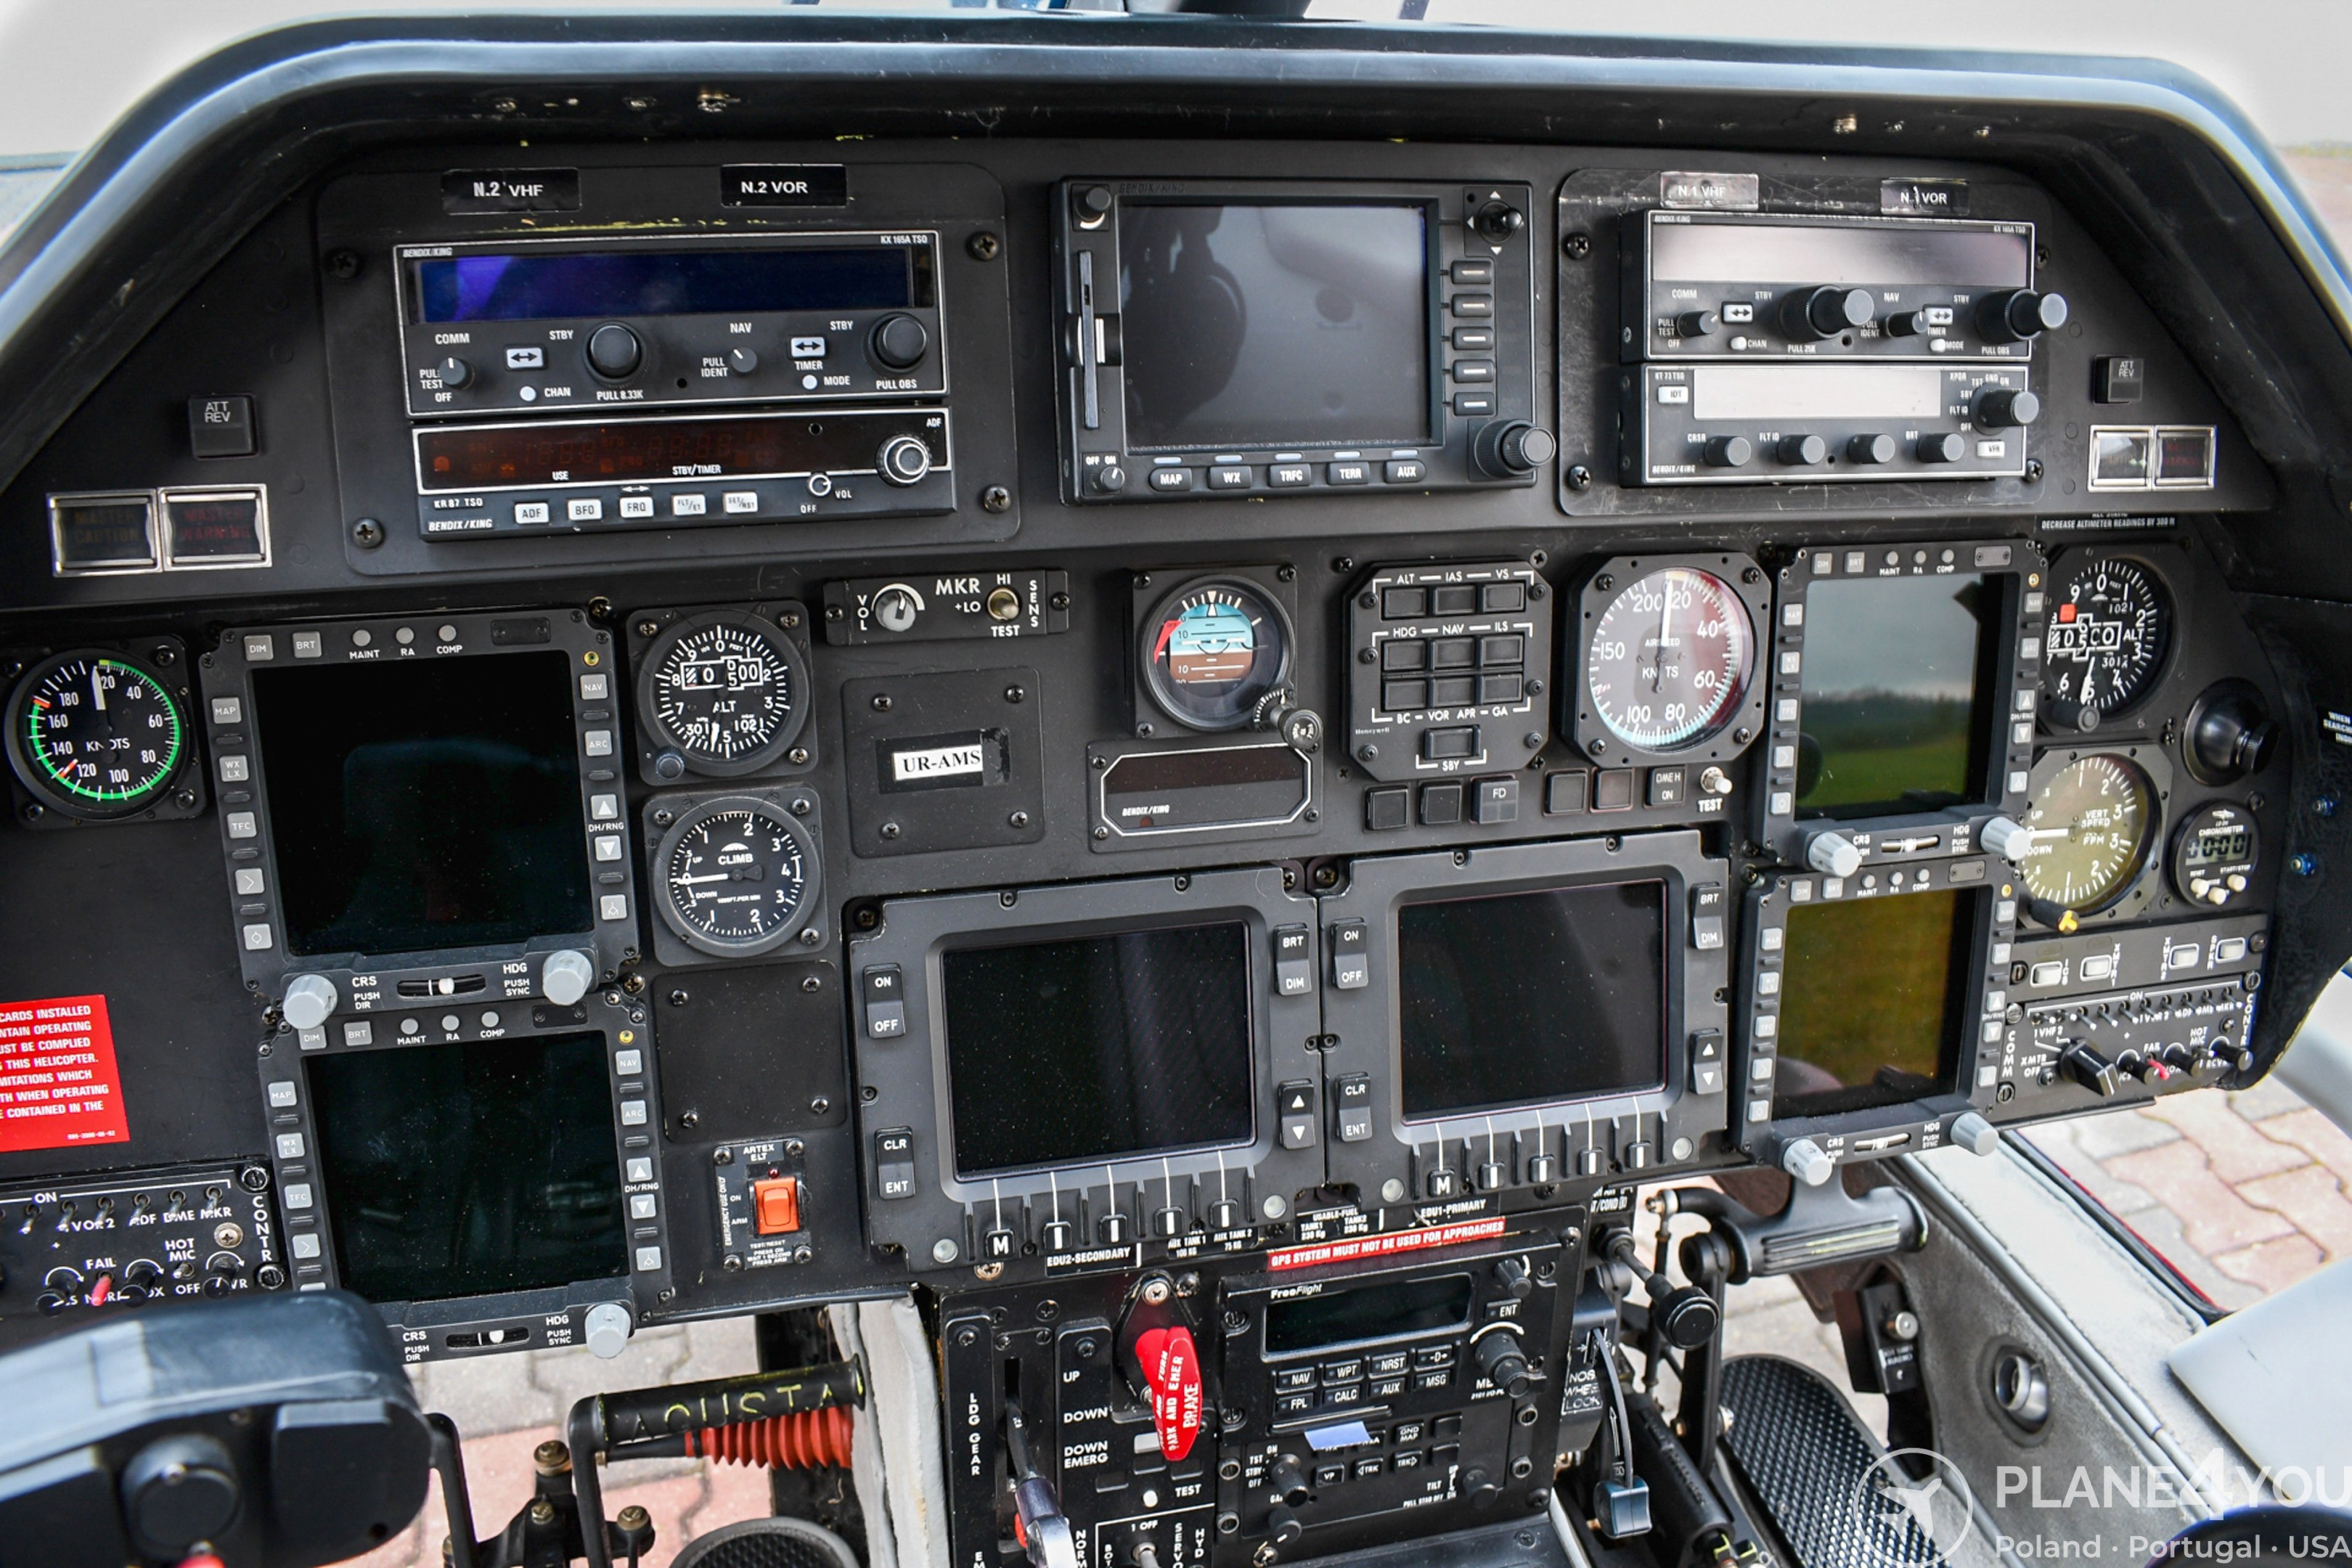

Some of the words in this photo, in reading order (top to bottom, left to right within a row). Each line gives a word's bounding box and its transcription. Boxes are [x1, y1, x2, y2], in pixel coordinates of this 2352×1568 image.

[473, 181, 501, 197] N.2
[508, 184, 544, 197] VHF
[740, 181, 767, 194] N.2
[771, 181, 808, 194] VOR
[1678, 185, 1697, 196] N.1
[1701, 185, 1726, 197] VHF
[1671, 289, 1697, 299] COMM
[1755, 291, 1772, 301] STBY
[1883, 292, 1900, 303] NAV
[729, 322, 753, 335] NAV
[829, 320, 854, 331] STBY
[435, 332, 470, 346] COMM
[549, 330, 574, 341] STBY
[1747, 339, 1767, 348] CHAN
[794, 360, 823, 371] TIMER
[701, 367, 729, 378] IDENT
[823, 375, 851, 387] MODE
[435, 392, 453, 403] OFF
[544, 386, 571, 398] CHAN
[205, 401, 229, 412] ATT
[205, 411, 231, 422] REV
[1104, 455, 1116, 465] ON
[552, 470, 569, 481] USE
[671, 463, 722, 477] STBY/TIMER
[1280, 470, 1303, 482] TRFC
[1339, 467, 1363, 480] TERR
[1396, 465, 1417, 478] AUX
[1160, 473, 1183, 485] MAP
[1222, 472, 1241, 483] WX
[834, 489, 852, 499] VOL
[521, 507, 542, 518] ADF
[428, 518, 494, 532] BENDIX/KING
[996, 573, 1010, 585] HI
[1397, 573, 1416, 584] ALT
[1445, 571, 1463, 583] IAS
[1495, 568, 1510, 580] VS
[935, 578, 981, 596] MKR
[1028, 579, 1040, 628] SENS
[1633, 593, 1662, 613] 200
[857, 595, 870, 631] VOL
[990, 624, 1020, 637] TEST
[1393, 626, 1417, 638] HDG
[1442, 624, 1465, 634] NAV
[1494, 621, 1509, 632] ILS
[1696, 621, 1718, 638] 40
[2123, 628, 2144, 642] ALT
[295, 640, 316, 650] BRT
[436, 645, 463, 654] COMP
[1600, 642, 1625, 660] 150
[349, 649, 380, 660] MAINT
[400, 648, 415, 656] RA
[1694, 670, 1715, 689] 60
[126, 685, 142, 700] 40
[584, 682, 603, 693] NAV
[59, 692, 80, 707] 180
[713, 700, 737, 714] ALT
[1665, 703, 1686, 721] 80
[1397, 712, 1411, 724] BC
[1427, 709, 1450, 722] VOR
[1456, 708, 1477, 719] APR
[1492, 706, 1508, 716] GA
[1625, 705, 1651, 724] 100
[48, 714, 69, 729] 160
[147, 714, 163, 729] 60
[1355, 727, 1390, 735] Honeywell
[52, 740, 74, 756] 140
[588, 740, 608, 748] ARC
[140, 749, 157, 764] 80
[903, 749, 981, 773] UR-AMS
[76, 763, 97, 777] 120
[108, 769, 130, 783] 100
[1493, 788, 1507, 799] FD
[1697, 798, 1723, 813] TEST
[231, 821, 250, 830] TFC
[589, 821, 624, 833] DH/RNG
[1953, 825, 1970, 835] HDG
[2198, 825, 2245, 838] CHRONOMETER
[1853, 834, 1871, 846] CRS
[718, 853, 754, 865] CLIMB
[1699, 893, 1719, 905] BRT
[1282, 936, 1304, 948] BRT
[1343, 930, 1359, 942] ON
[1701, 932, 1718, 944] DIM
[502, 963, 528, 974] HDG
[351, 976, 377, 987] CRS
[874, 976, 892, 988] ON
[1341, 970, 1363, 983] OFF
[504, 978, 530, 989] PUSH
[1285, 977, 1304, 989] DIM
[354, 992, 380, 1002] PUSH
[505, 987, 530, 997] SYNC
[2129, 991, 2144, 1001] ON
[354, 1001, 371, 1010] DIR
[36, 1005, 91, 1020] INSTALLED
[874, 1019, 899, 1032] OFF
[479, 1028, 506, 1039] COMP
[396, 1035, 427, 1046] MAINT
[5, 1058, 31, 1071] THIS
[33, 1053, 99, 1068] HELICOPTER.
[1344, 1084, 1366, 1096] CLR
[6, 1103, 66, 1119] CONTAINED
[69, 1102, 81, 1114] IN
[83, 1100, 105, 1112] THE
[1345, 1123, 1366, 1136] ENT
[883, 1139, 907, 1151] CLR
[1826, 1137, 1845, 1148] CRS
[743, 1143, 775, 1156] ARTEX
[750, 1152, 767, 1162] ELT
[624, 1183, 660, 1193] DH/RNG
[886, 1180, 909, 1193] ENT
[34, 1192, 57, 1204] ON
[1420, 1199, 1487, 1219] EDU1-PRIMARY
[164, 1238, 195, 1251] HOT
[992, 1236, 1009, 1256] M
[1270, 1254, 1291, 1267] GPS
[1293, 1247, 1331, 1265] SYSTEM
[1332, 1243, 1360, 1257] MUST
[1361, 1241, 1381, 1254] NOT
[1382, 1238, 1395, 1250] BE
[1397, 1234, 1421, 1248] USED
[1423, 1230, 1442, 1244] FOR
[1443, 1220, 1505, 1241] APPROACHES
[168, 1249, 196, 1262] MIC
[1046, 1246, 1131, 1267] EDU2-SECONDARY
[85, 1258, 116, 1270] FAIL
[175, 1283, 201, 1295] OFF
[1270, 1283, 1323, 1299] FreeFlight
[1499, 1304, 1517, 1318] ENT
[545, 1314, 570, 1326] HDG
[401, 1330, 428, 1342] CRS
[547, 1328, 571, 1338] PUSH
[548, 1336, 571, 1346] SYNC
[404, 1344, 430, 1354] PUSH
[405, 1352, 421, 1362] DIR
[1063, 1370, 1080, 1383] UP
[1291, 1372, 1310, 1386] NAV
[1336, 1364, 1357, 1379] WPT
[1381, 1357, 1405, 1371] NRST
[1291, 1397, 1308, 1411] FPL
[1334, 1389, 1357, 1403] CALC
[1381, 1381, 1401, 1395] AUX
[1426, 1373, 1447, 1388] MSG
[968, 1392, 981, 1426] LDG
[1183, 1382, 1199, 1429] BRAKE
[1063, 1407, 1108, 1424] DOWN
[968, 1432, 981, 1476] GEAR
[1063, 1440, 1108, 1458] DOWN
[1063, 1453, 1108, 1469] EMERG
[1175, 1484, 1202, 1498] TEST
